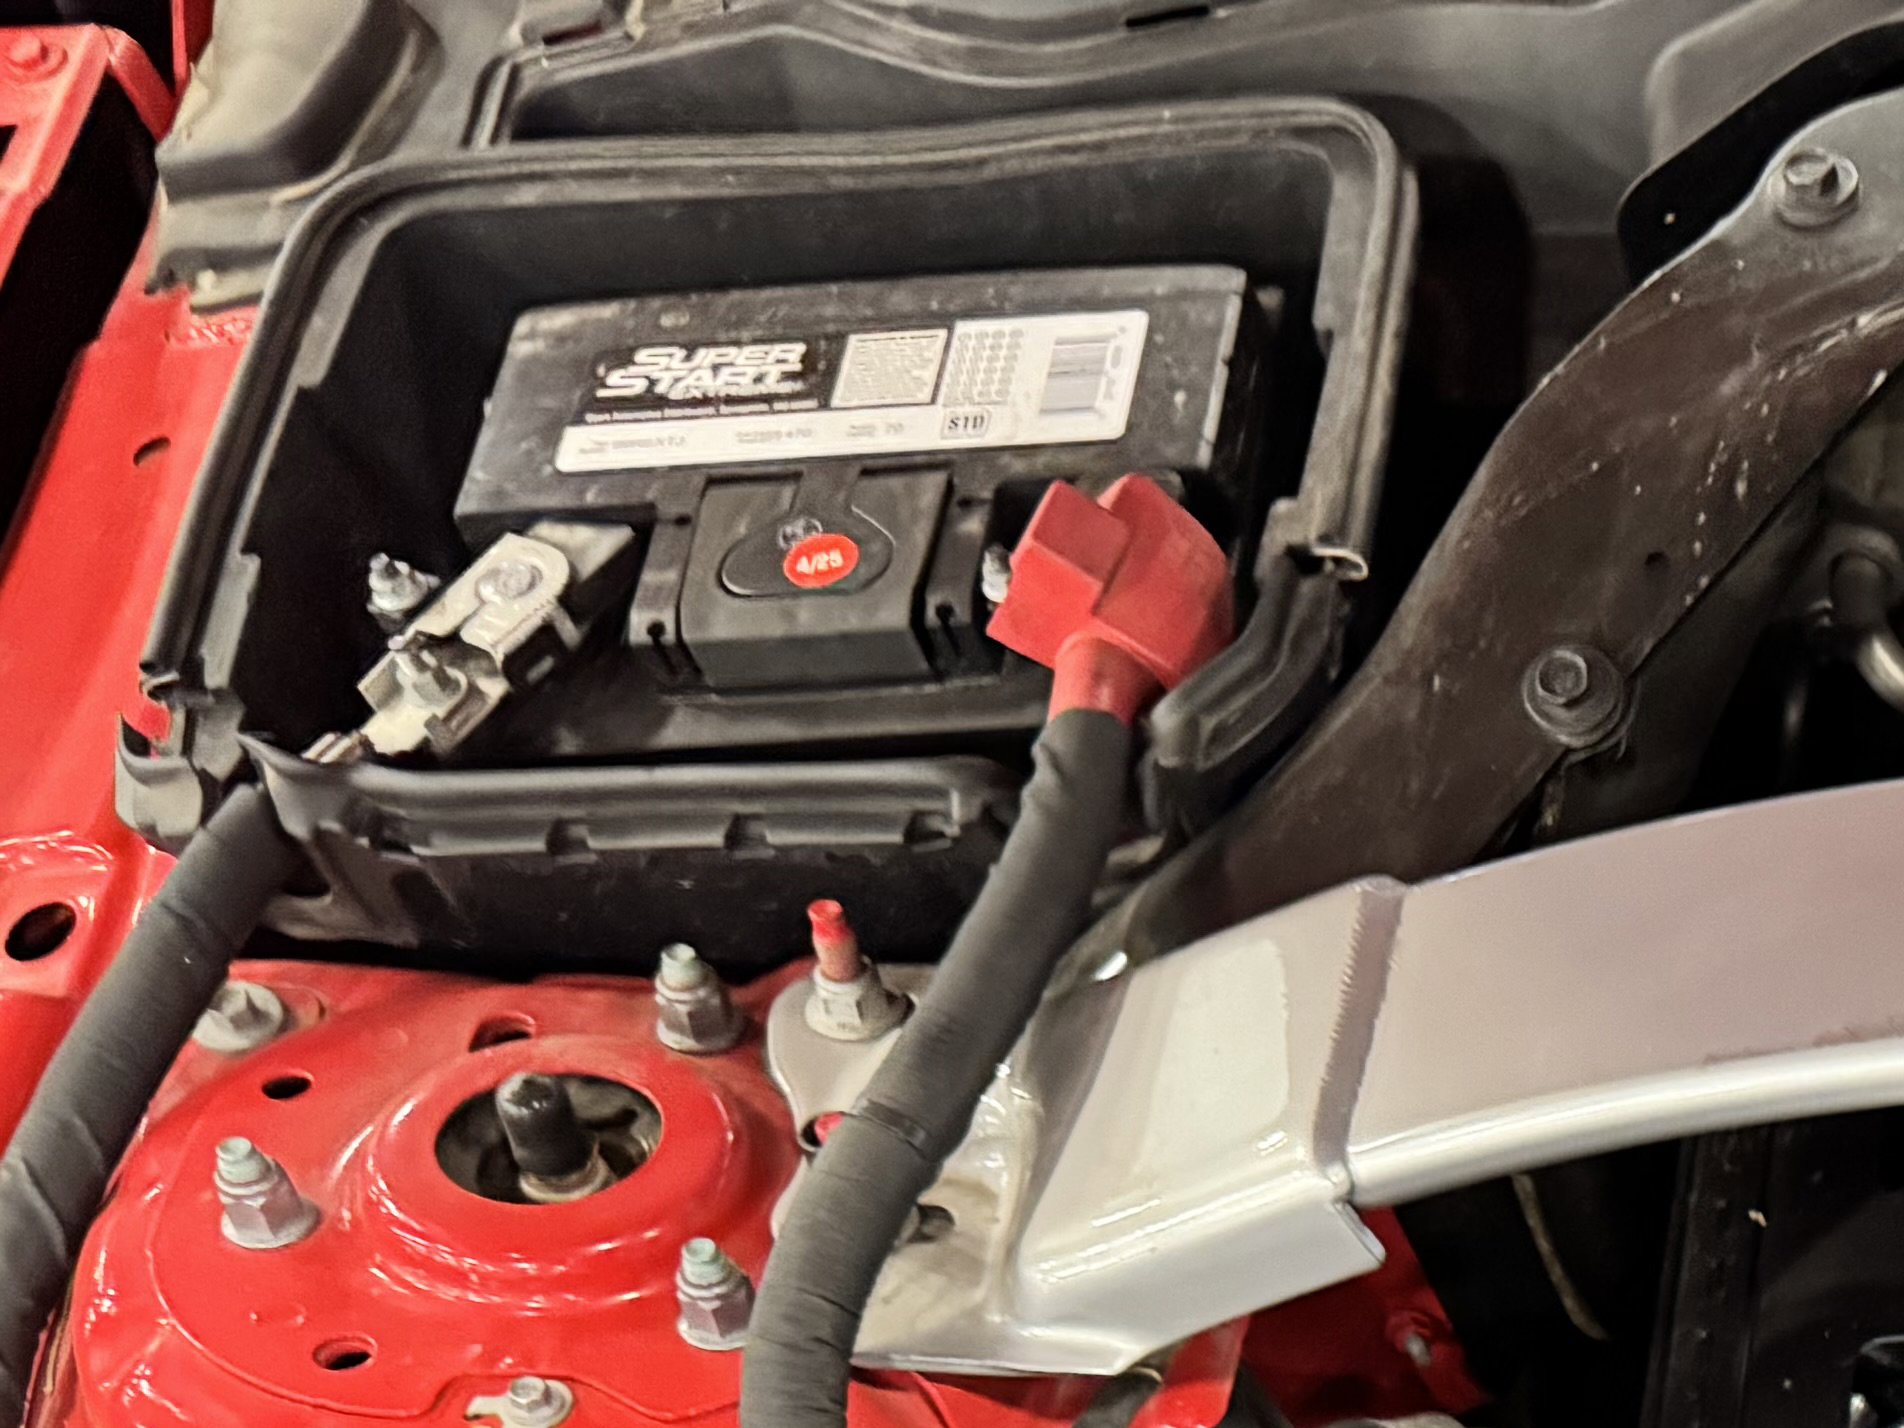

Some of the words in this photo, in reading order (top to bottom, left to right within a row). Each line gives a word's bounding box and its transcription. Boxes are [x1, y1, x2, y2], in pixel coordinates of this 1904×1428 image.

[633, 340, 808, 371] SUPER
[596, 362, 804, 399] START
[795, 548, 844, 576] 4/25
